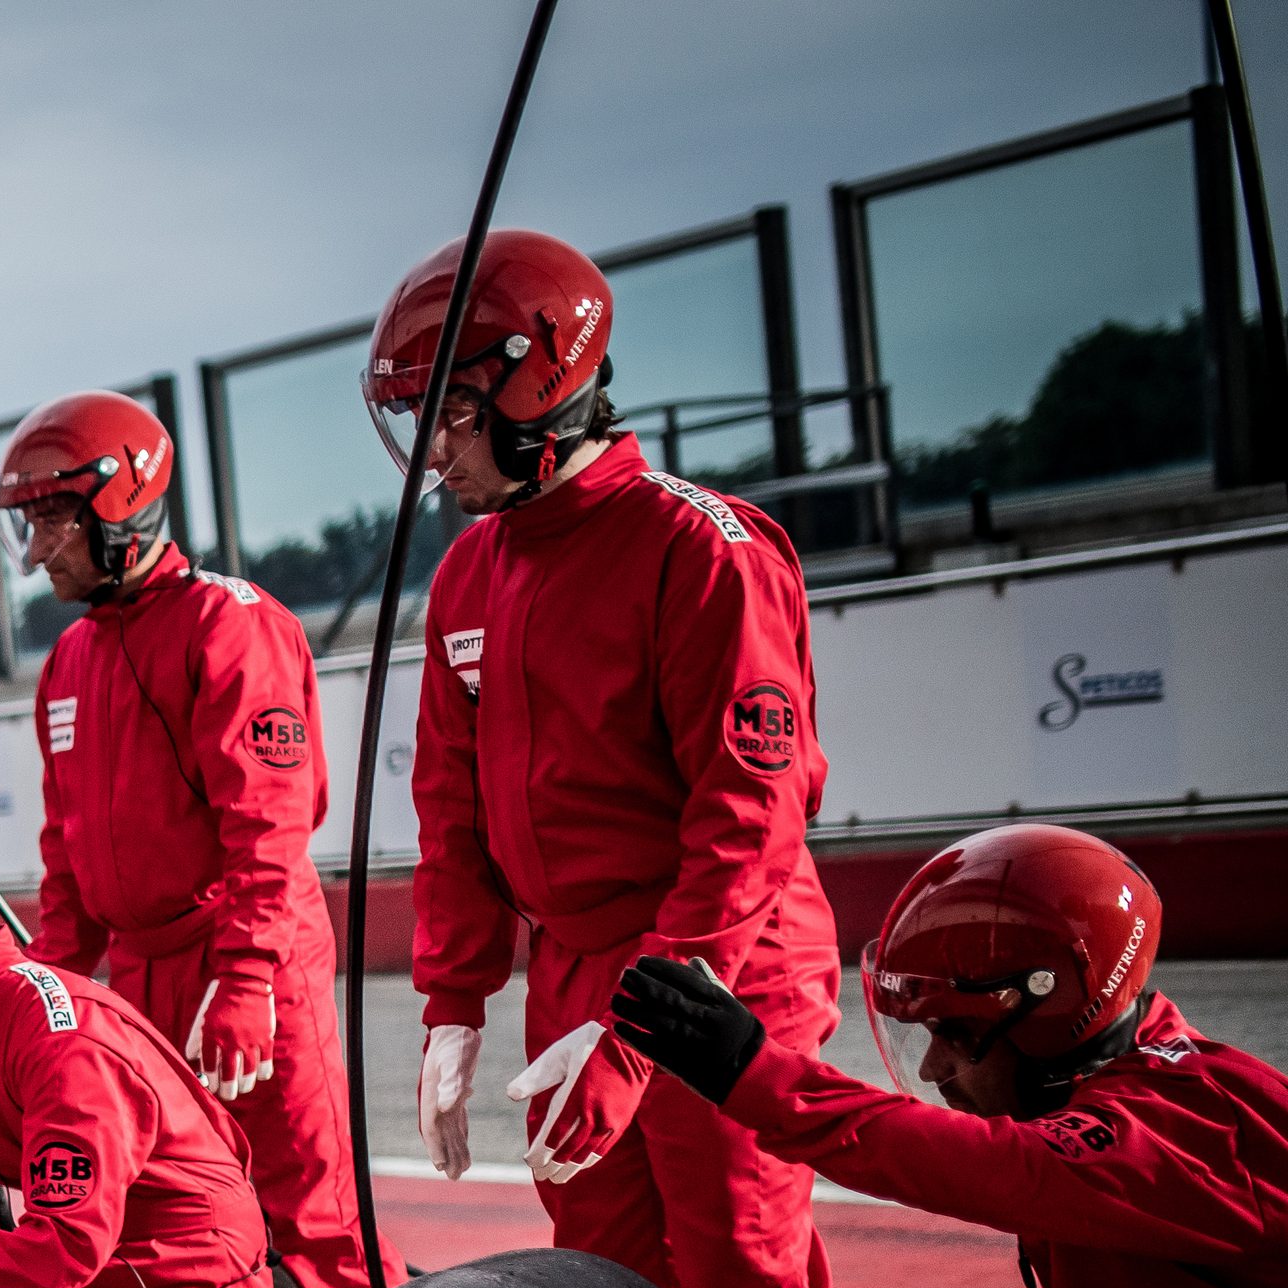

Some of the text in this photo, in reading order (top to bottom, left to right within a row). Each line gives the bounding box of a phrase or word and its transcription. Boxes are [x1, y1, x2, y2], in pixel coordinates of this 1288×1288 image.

[565, 297, 604, 366] METRICOS
[251, 720, 306, 744] M5B
[734, 701, 795, 737] M5B
[255, 746, 305, 758] BRAKES
[1101, 916, 1146, 998] METRICOS
[30, 1154, 93, 1186] M5B
[30, 1183, 87, 1199] BRAKES
